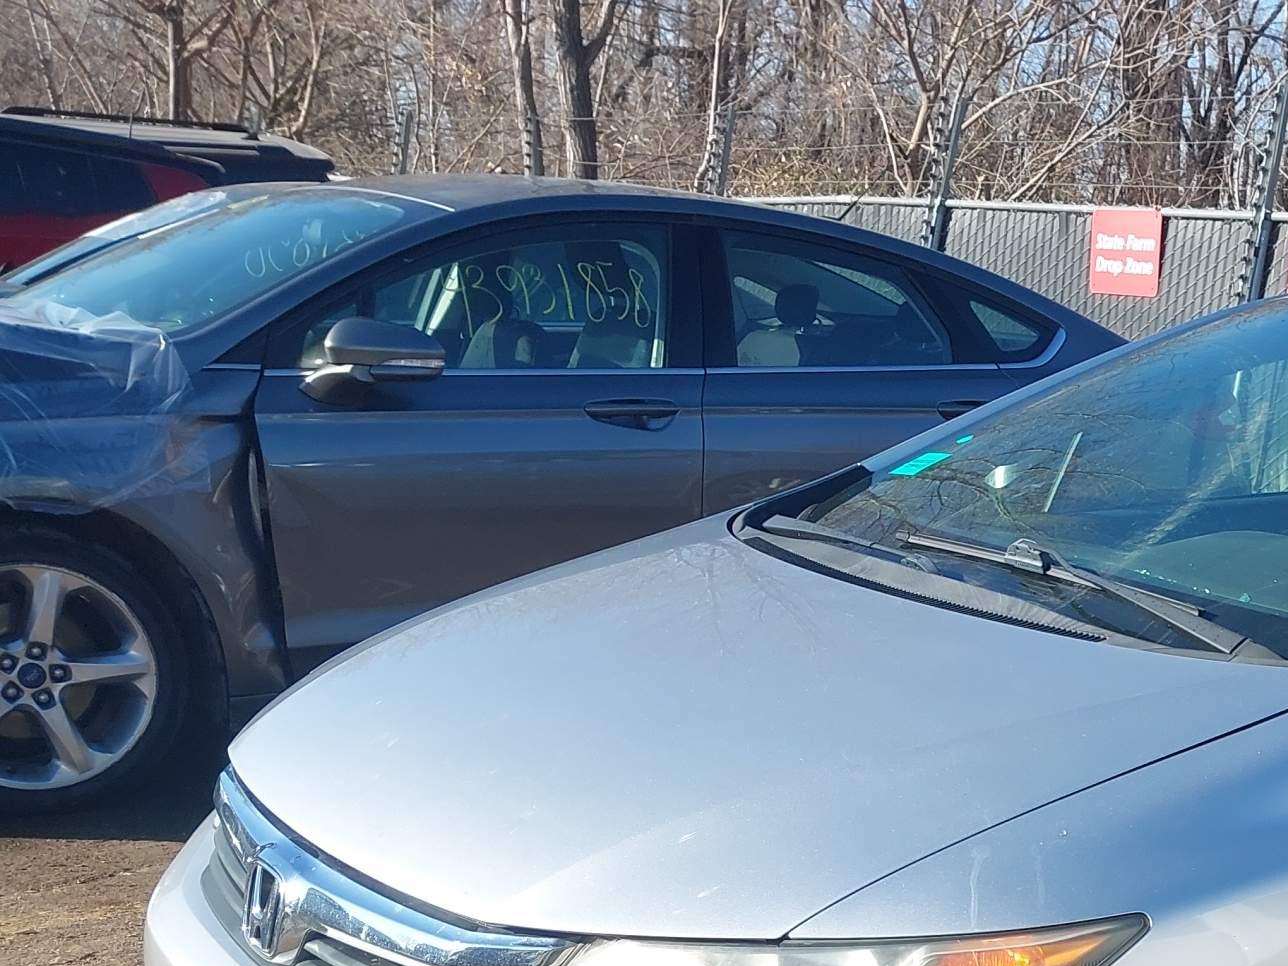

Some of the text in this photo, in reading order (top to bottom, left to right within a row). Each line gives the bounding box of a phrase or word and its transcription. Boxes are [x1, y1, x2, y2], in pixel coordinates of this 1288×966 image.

[1096, 233, 1155, 251] State Farm
[1095, 256, 1153, 277] Drop Zone
